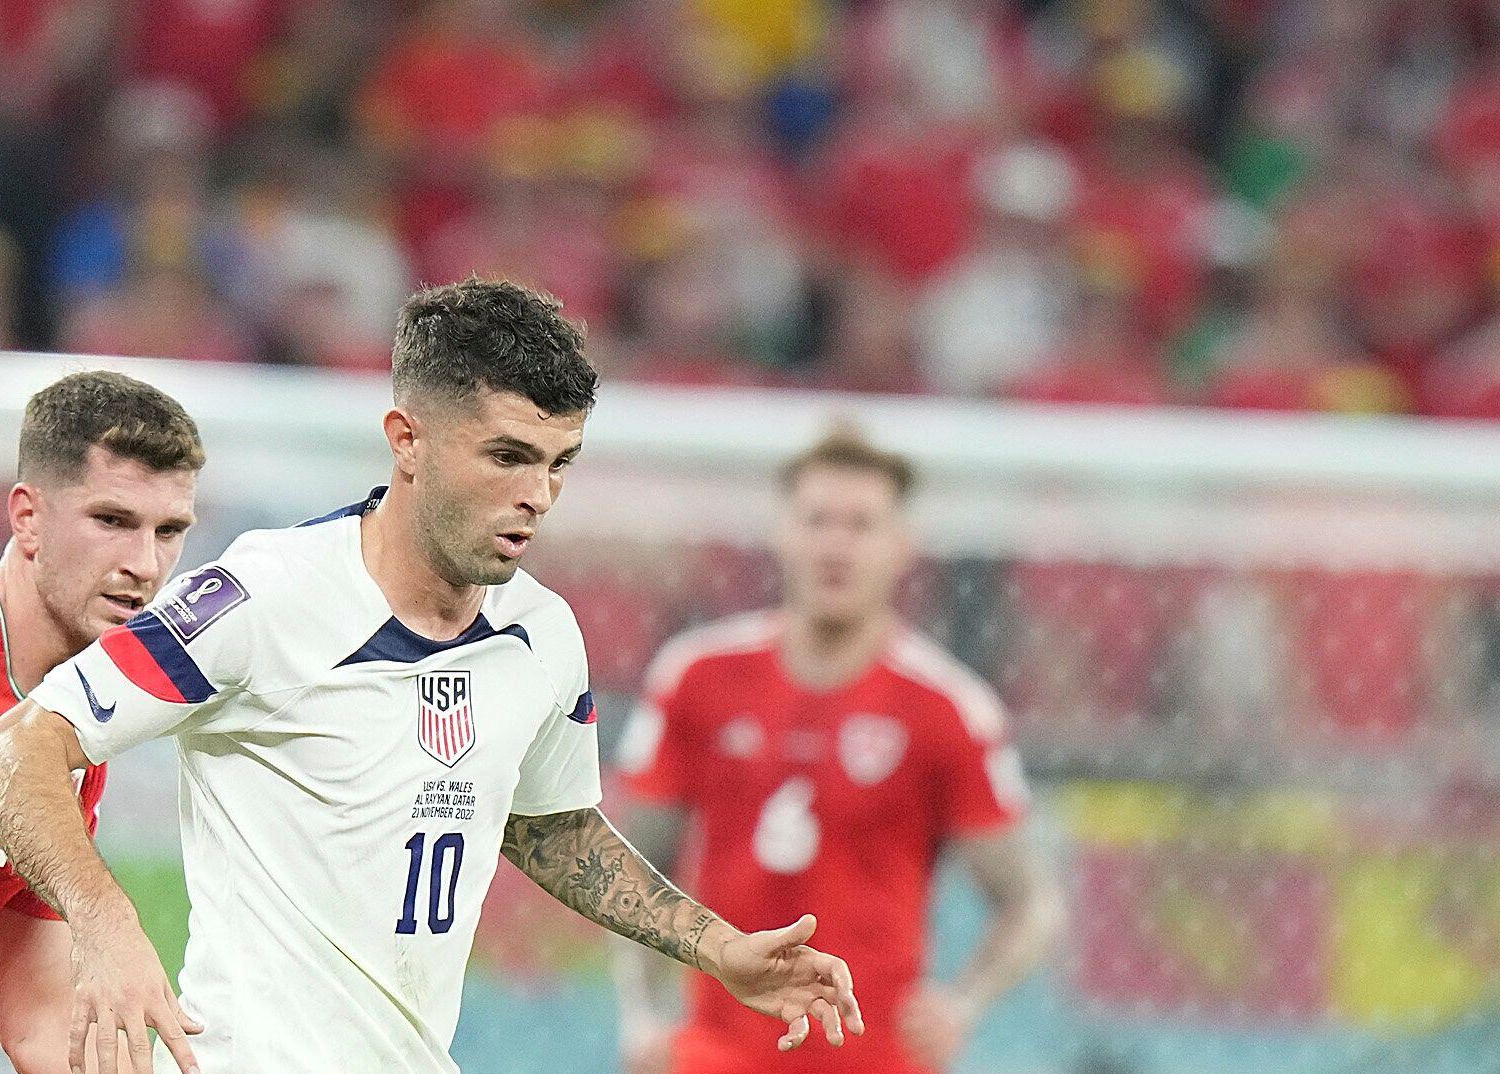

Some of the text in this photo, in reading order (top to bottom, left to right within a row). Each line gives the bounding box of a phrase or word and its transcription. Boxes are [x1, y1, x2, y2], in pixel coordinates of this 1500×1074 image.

[421, 676, 466, 712] USA
[449, 781, 474, 793] WALES
[411, 806, 475, 820] 21 NOVEMBER 2022
[415, 794, 423, 805] AL
[453, 794, 476, 807] QATAR
[753, 776, 822, 875] 6
[395, 832, 465, 934] 10
